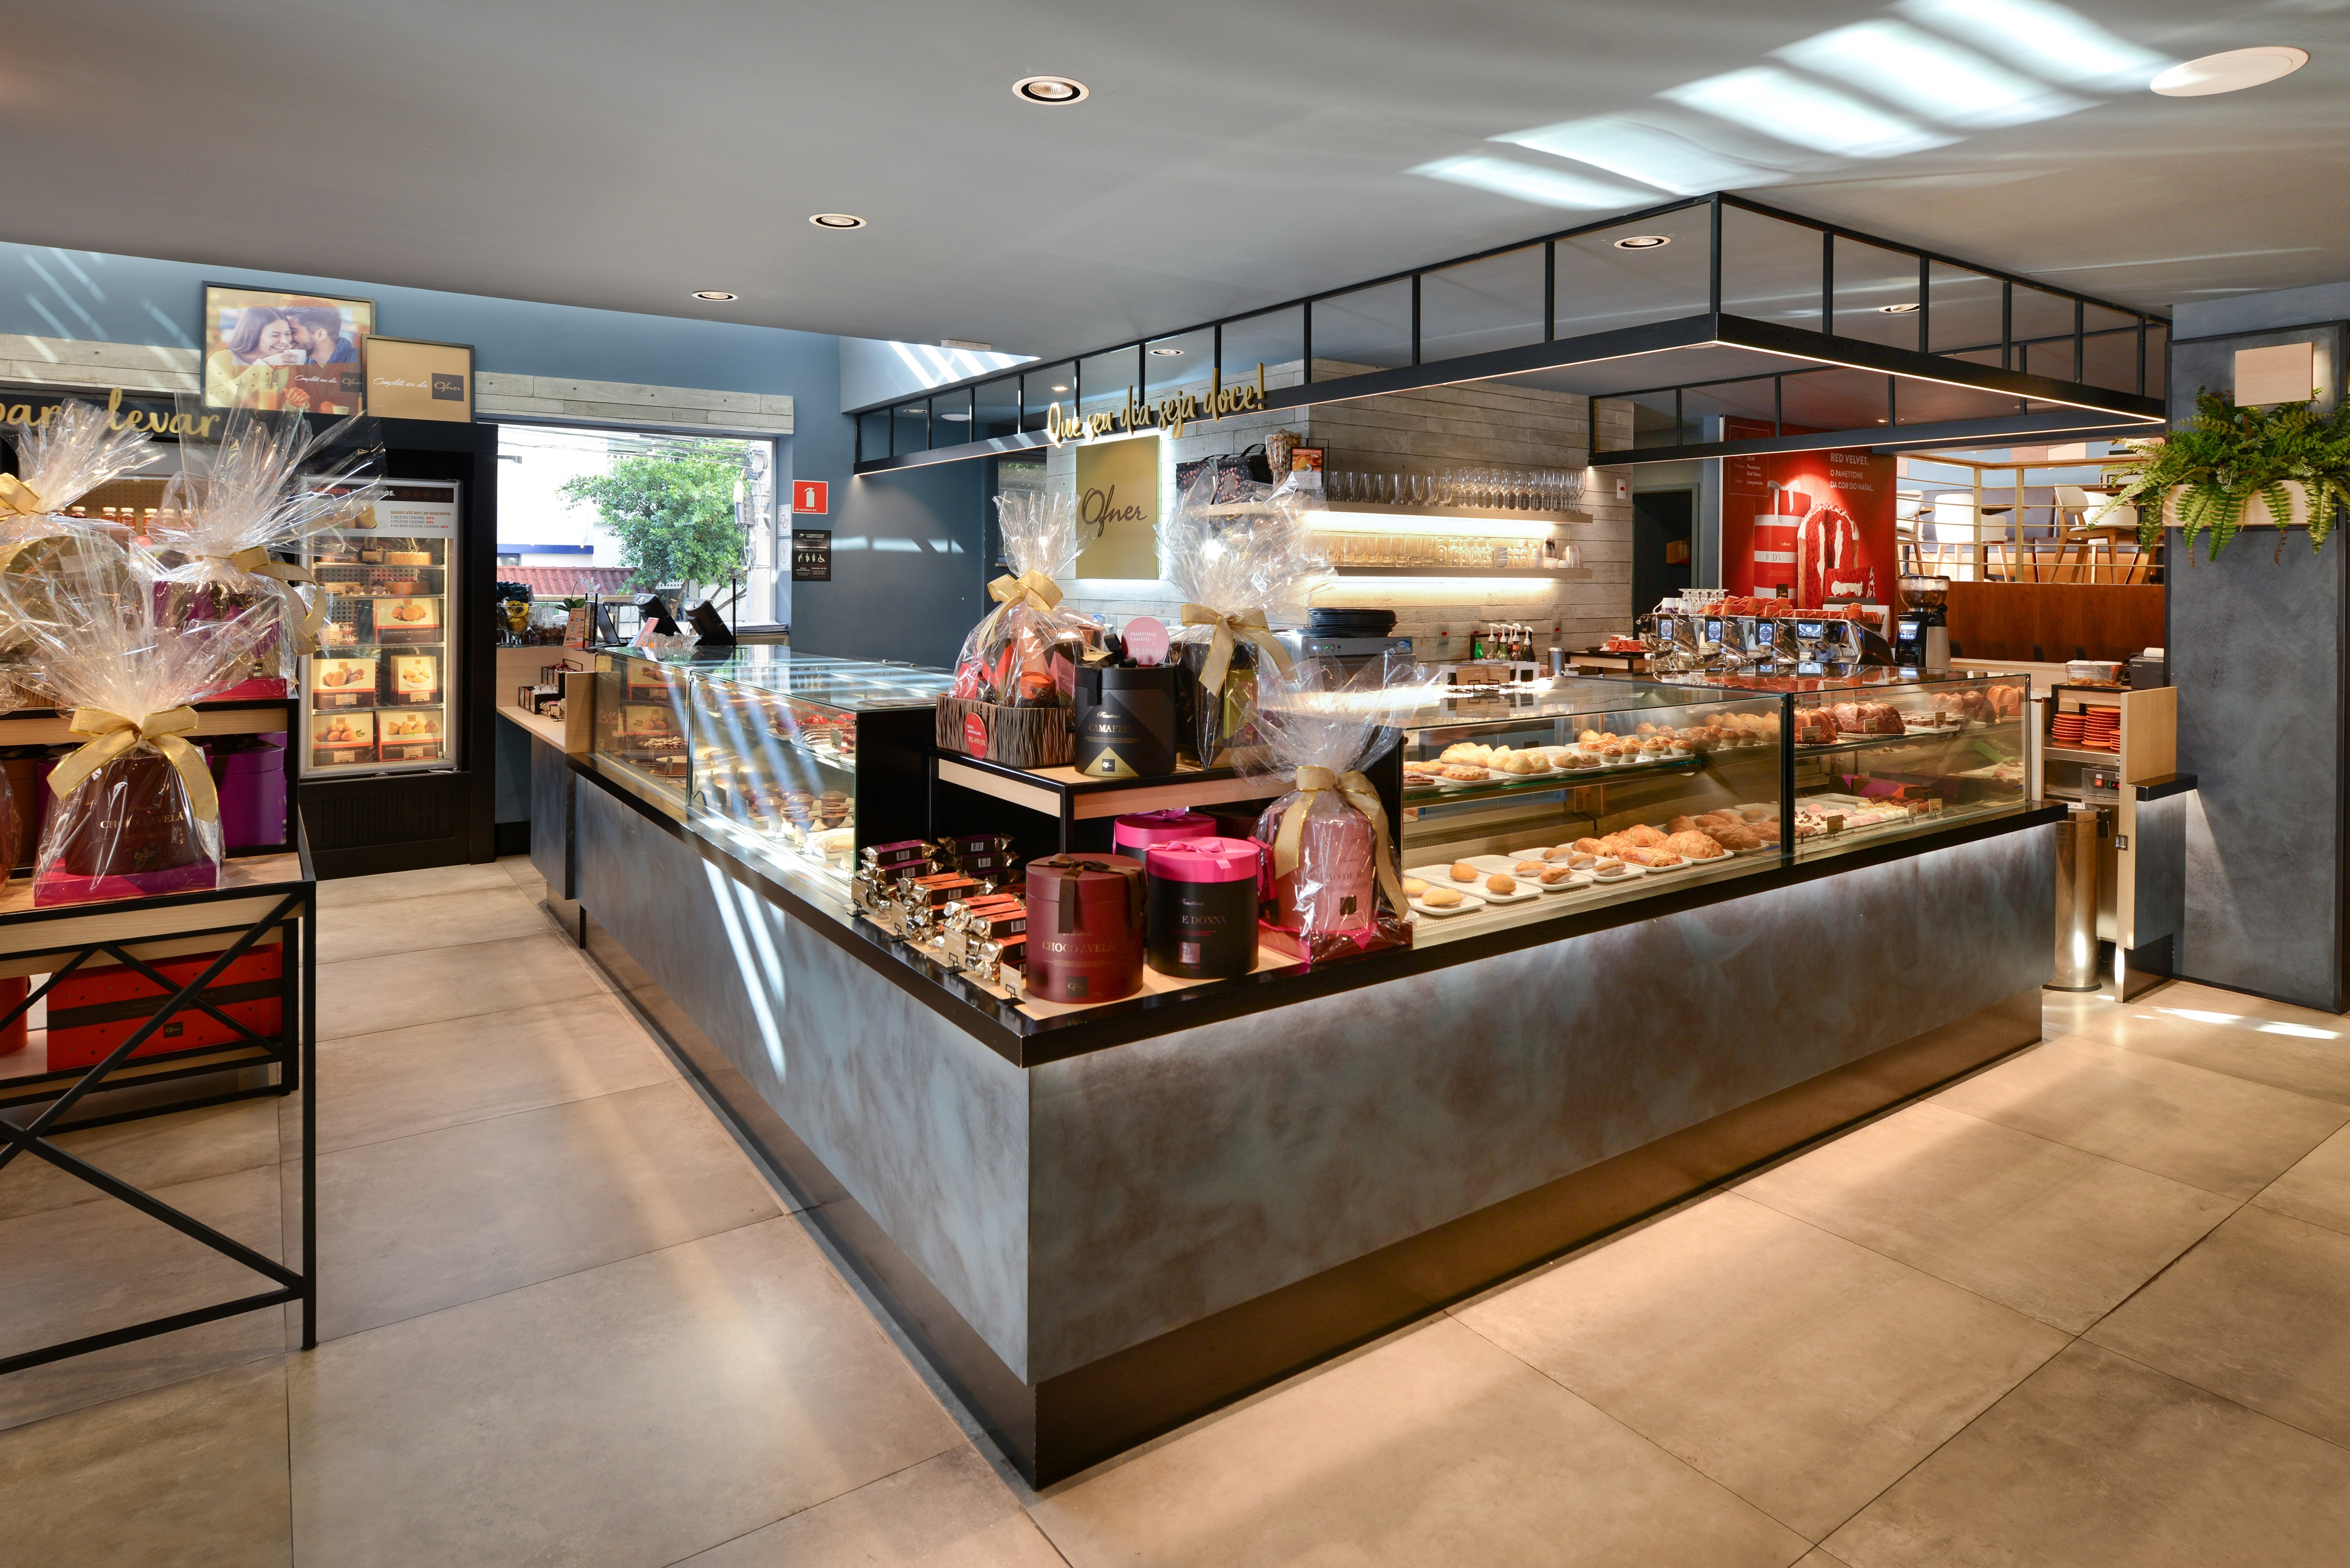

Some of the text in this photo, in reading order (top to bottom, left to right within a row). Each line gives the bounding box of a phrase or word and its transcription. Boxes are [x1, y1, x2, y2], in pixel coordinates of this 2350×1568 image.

[1047, 362, 1265, 449] Que seu dia seja doce!
[108, 387, 220, 437] levar
[1830, 453, 1869, 466] RED VELVET.
[1836, 470, 1863, 479] PANETTONE
[1858, 483, 1874, 491] NATAL.
[1081, 484, 1147, 537] Ofner
[1089, 724, 1131, 733] CAMAFEU
[1191, 916, 1227, 924] DONNA
[1042, 941, 1078, 952] CHOCO
